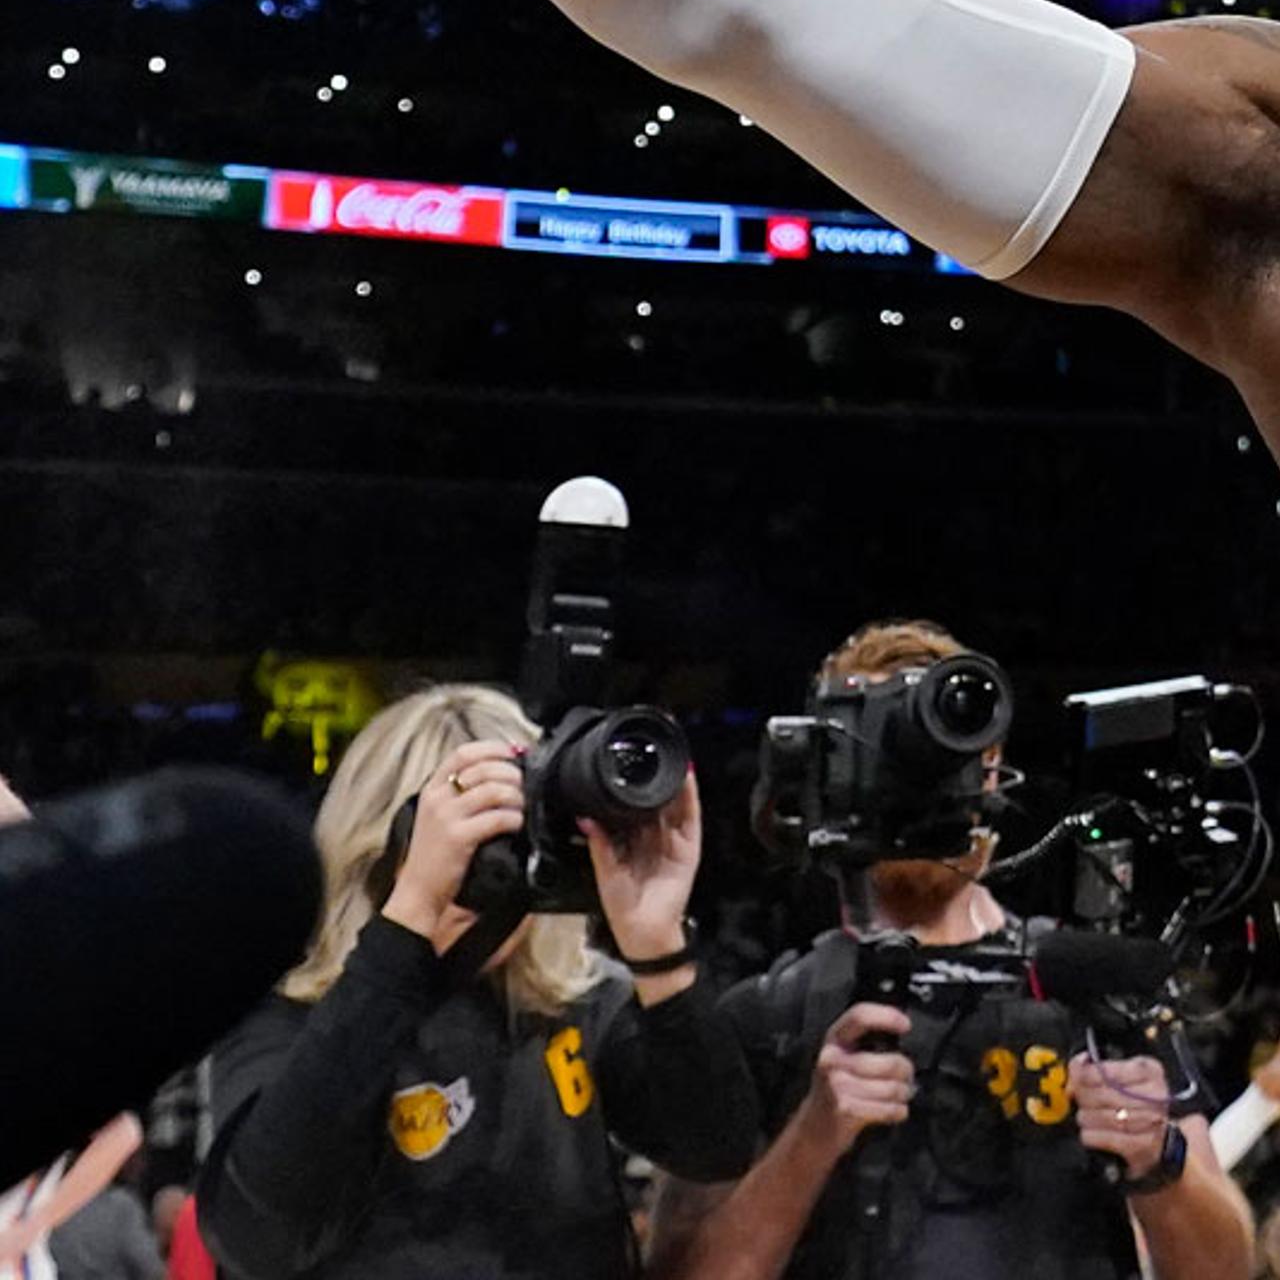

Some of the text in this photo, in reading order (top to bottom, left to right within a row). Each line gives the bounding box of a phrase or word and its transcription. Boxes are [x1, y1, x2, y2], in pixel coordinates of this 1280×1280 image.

[539, 215, 692, 249] Happy Birthday
[812, 225, 910, 256] TOYOTA
[545, 1026, 594, 1118] 6
